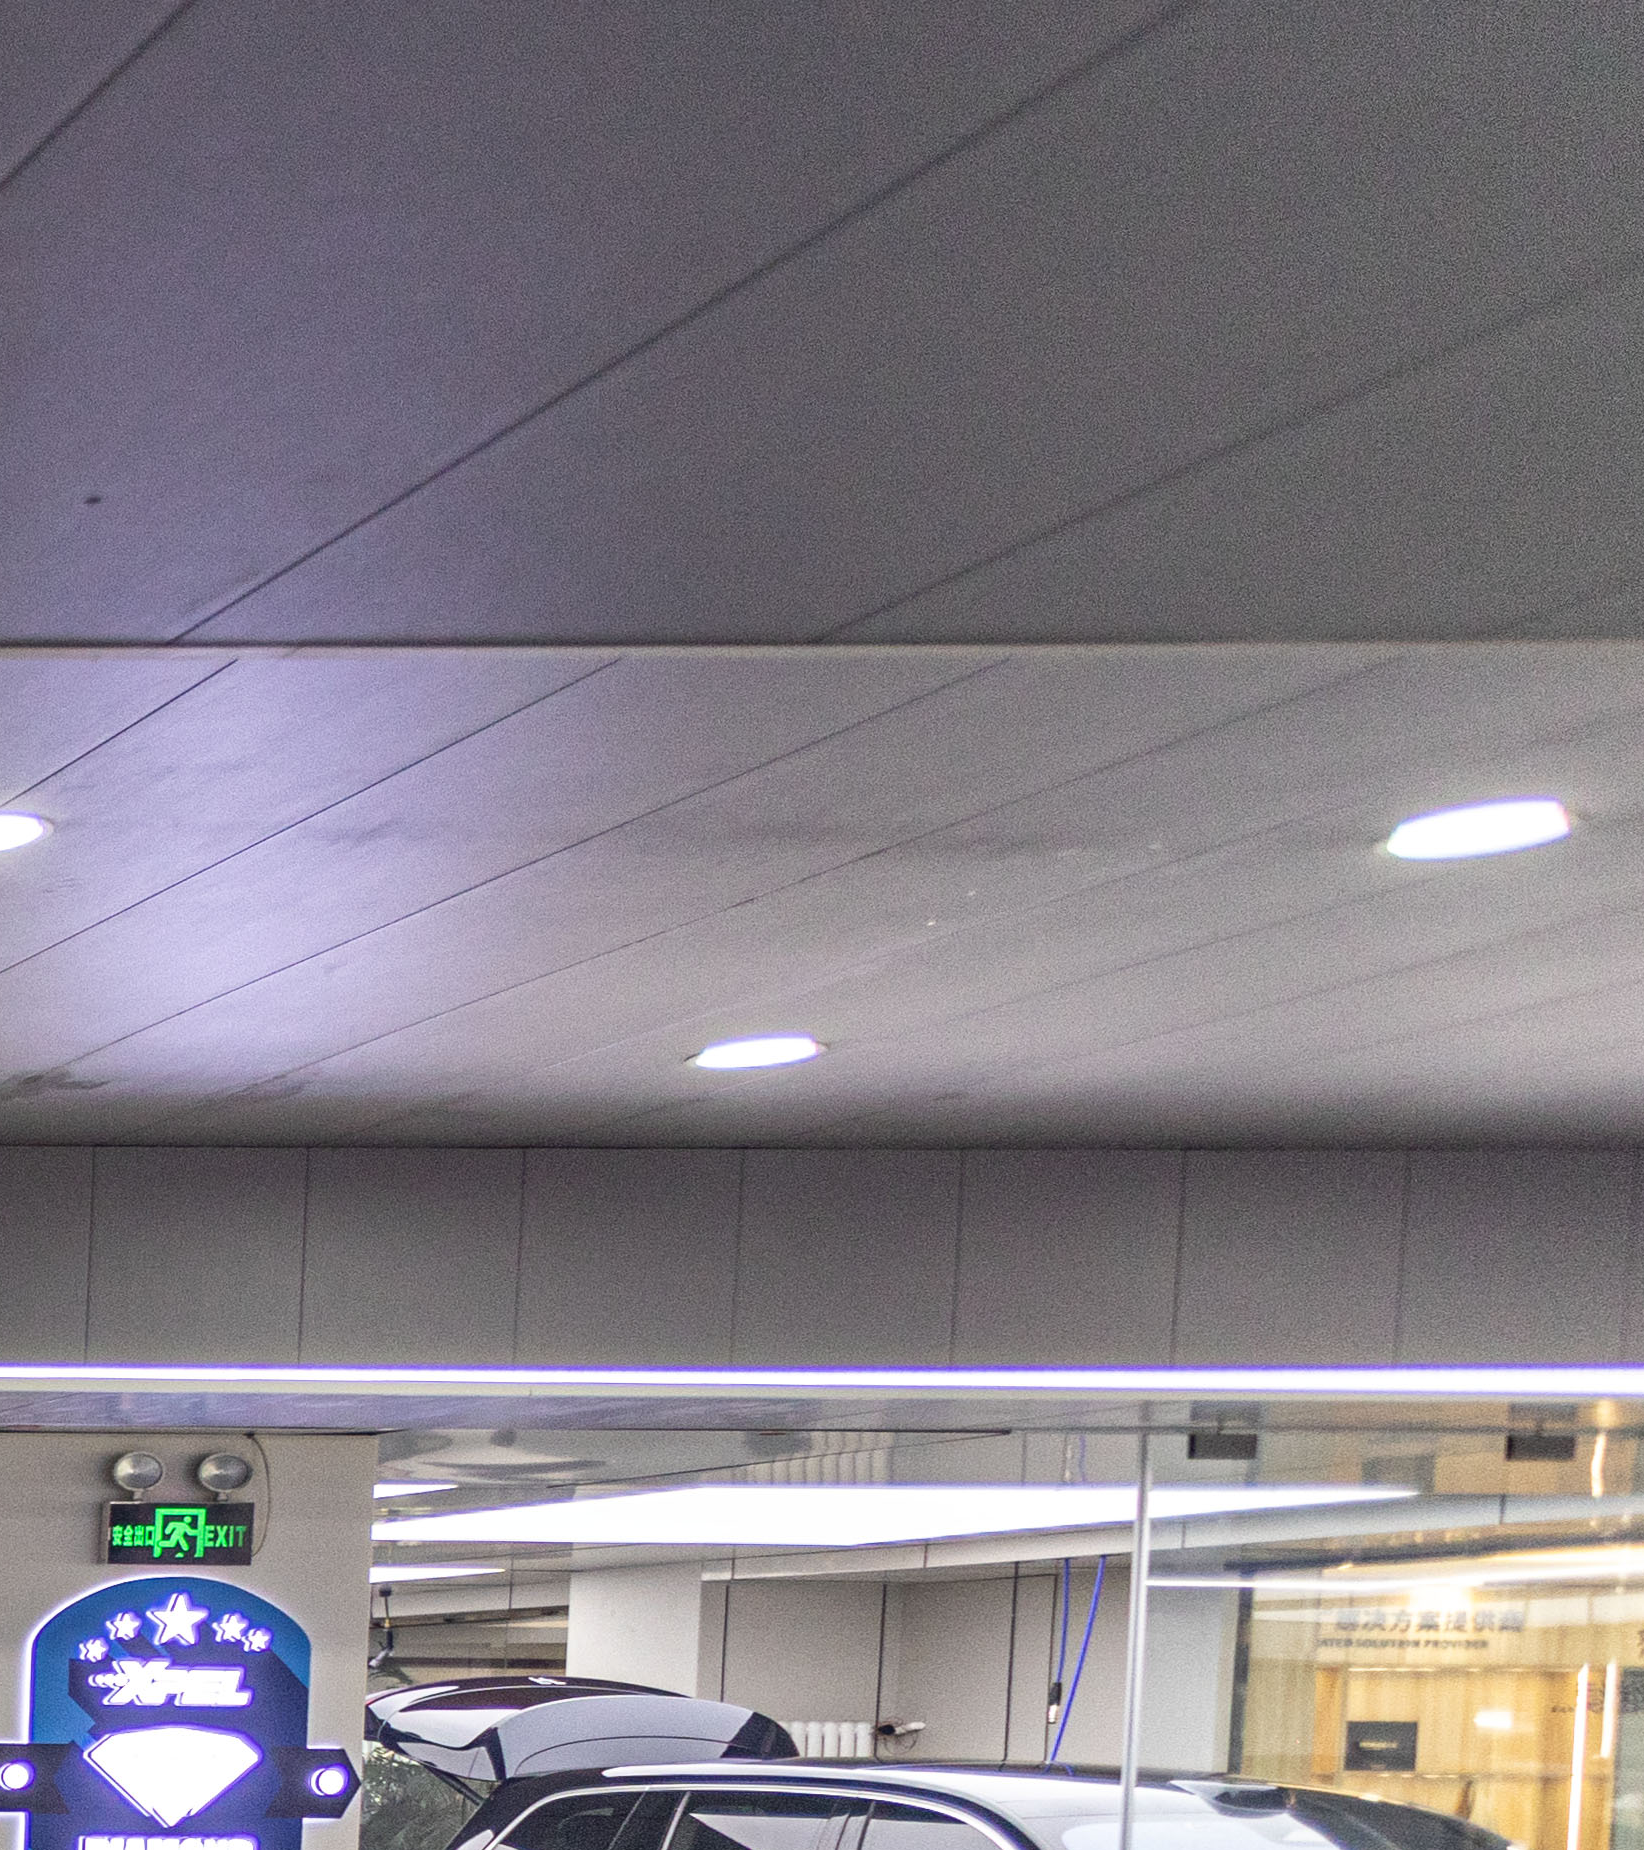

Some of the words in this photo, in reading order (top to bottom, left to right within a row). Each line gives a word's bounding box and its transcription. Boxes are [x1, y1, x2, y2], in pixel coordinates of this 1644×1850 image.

[112, 1525, 155, 1547] 安全出口
[204, 1525, 248, 1547] EXIT
